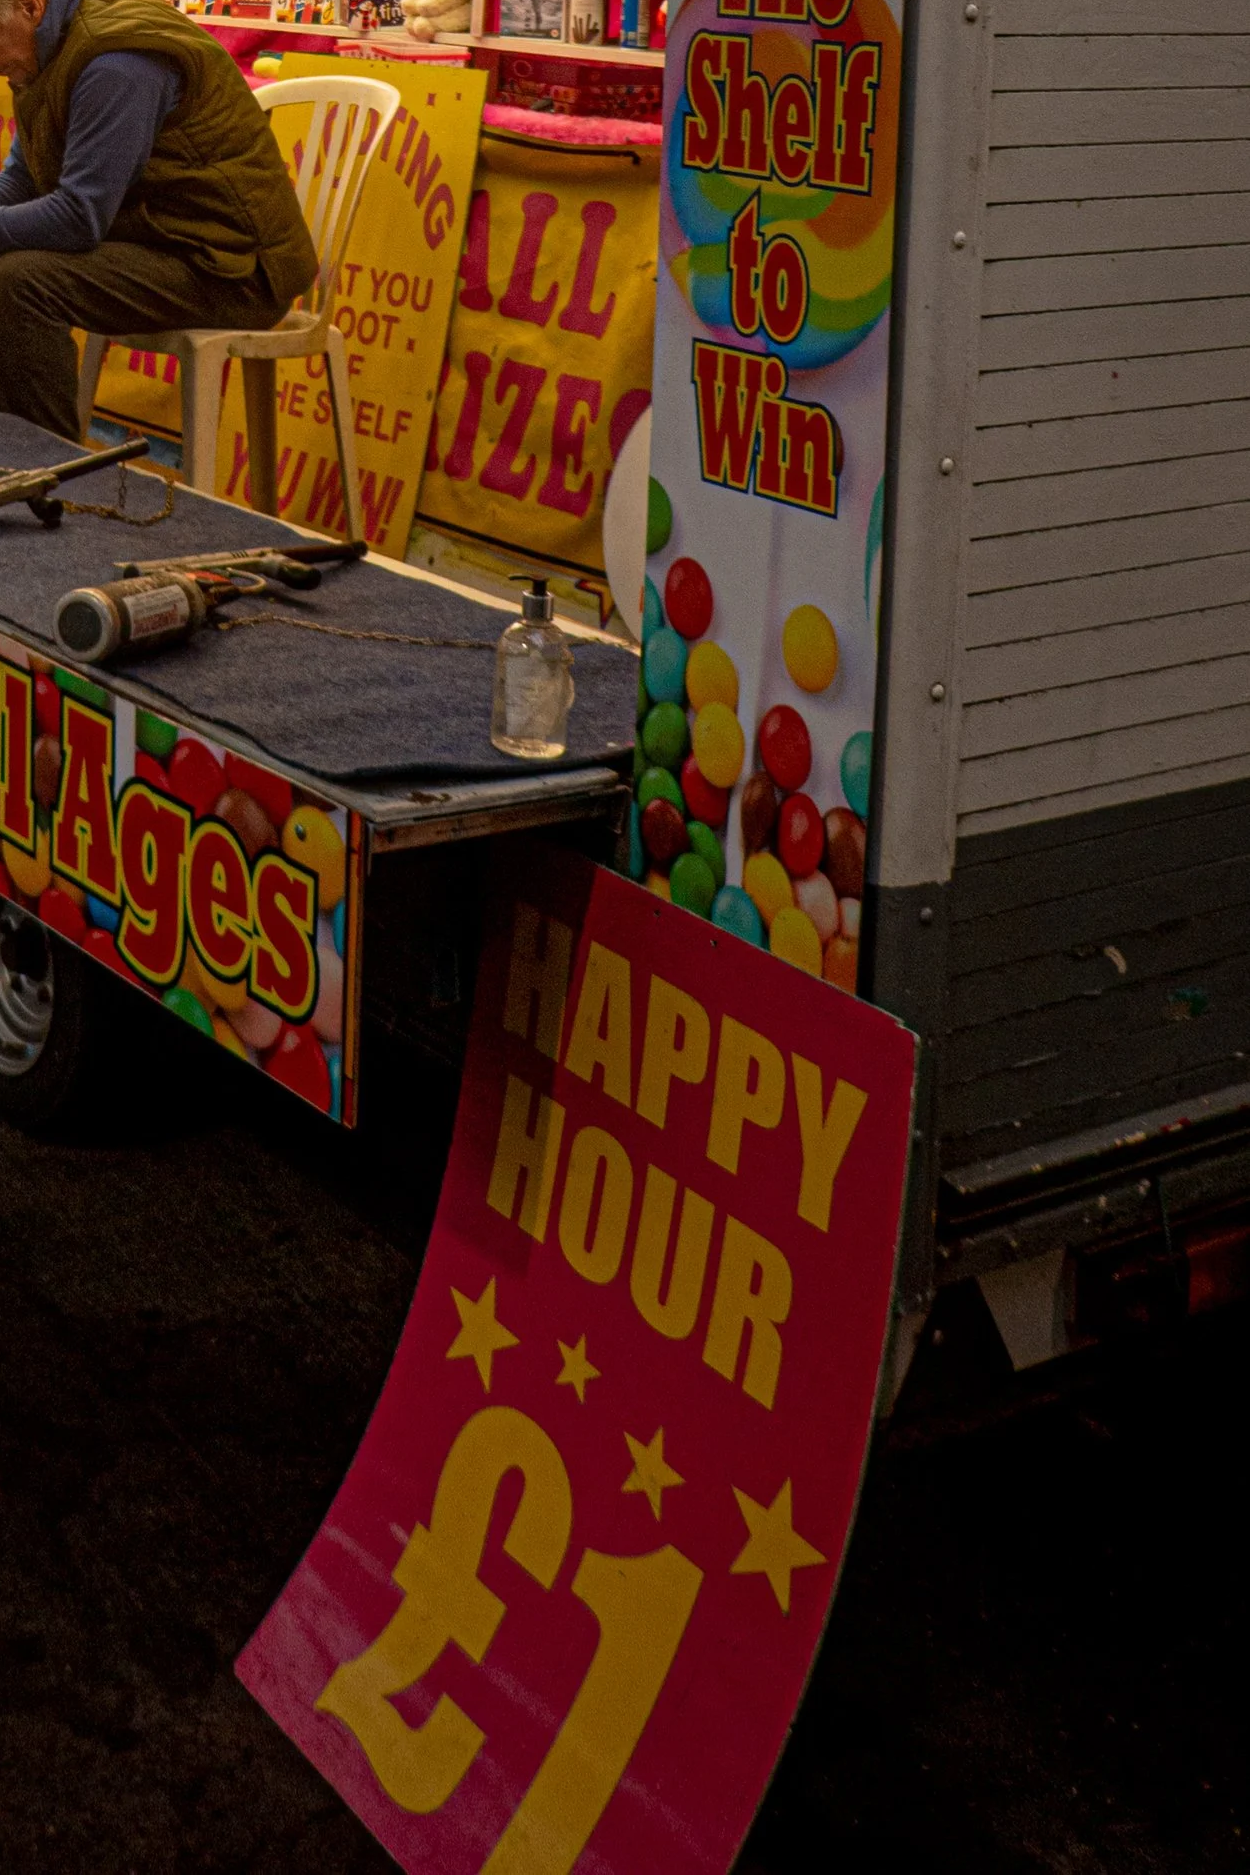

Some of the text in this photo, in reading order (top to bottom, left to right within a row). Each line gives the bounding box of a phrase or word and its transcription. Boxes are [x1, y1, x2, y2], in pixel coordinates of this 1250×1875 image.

[682, 28, 883, 195] Shelf
[334, 306, 401, 350] OOT
[370, 268, 434, 313] YOU
[728, 187, 808, 344] to
[276, 382, 413, 448] HE SELF
[305, 353, 366, 380] OF
[692, 337, 839, 519] Win
[225, 431, 308, 515] YU
[51, 688, 320, 1025] Ages
[502, 895, 868, 1233] HAPPY
[486, 1072, 794, 1411] HOUR
[314, 1404, 705, 1875] £1
